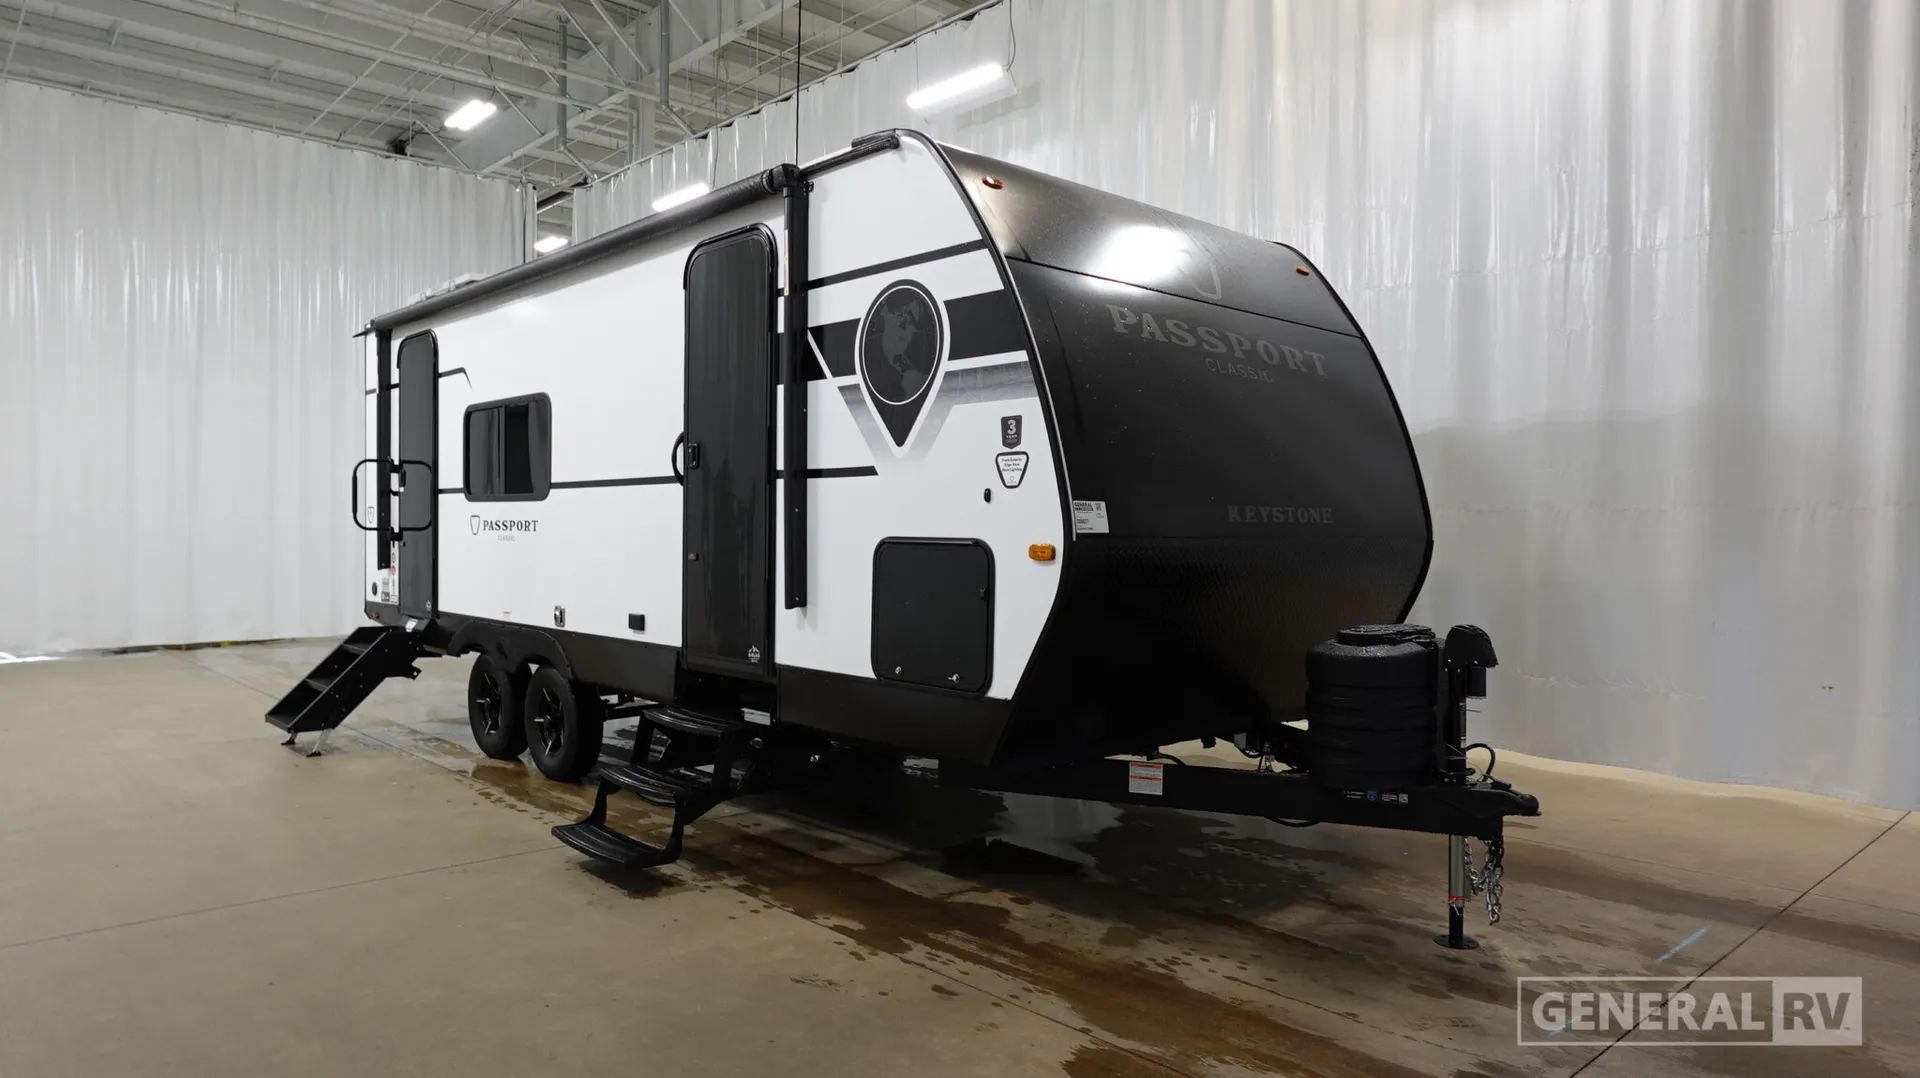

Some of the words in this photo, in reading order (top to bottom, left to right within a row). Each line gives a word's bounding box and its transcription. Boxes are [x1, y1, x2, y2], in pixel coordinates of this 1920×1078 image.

[1106, 303, 1328, 377] PASSPORT
[1205, 357, 1274, 383] CLASSIC
[1007, 419, 1016, 435] 3
[1226, 504, 1334, 524] KEYSTONE
[483, 519, 539, 532] PASSPORT
